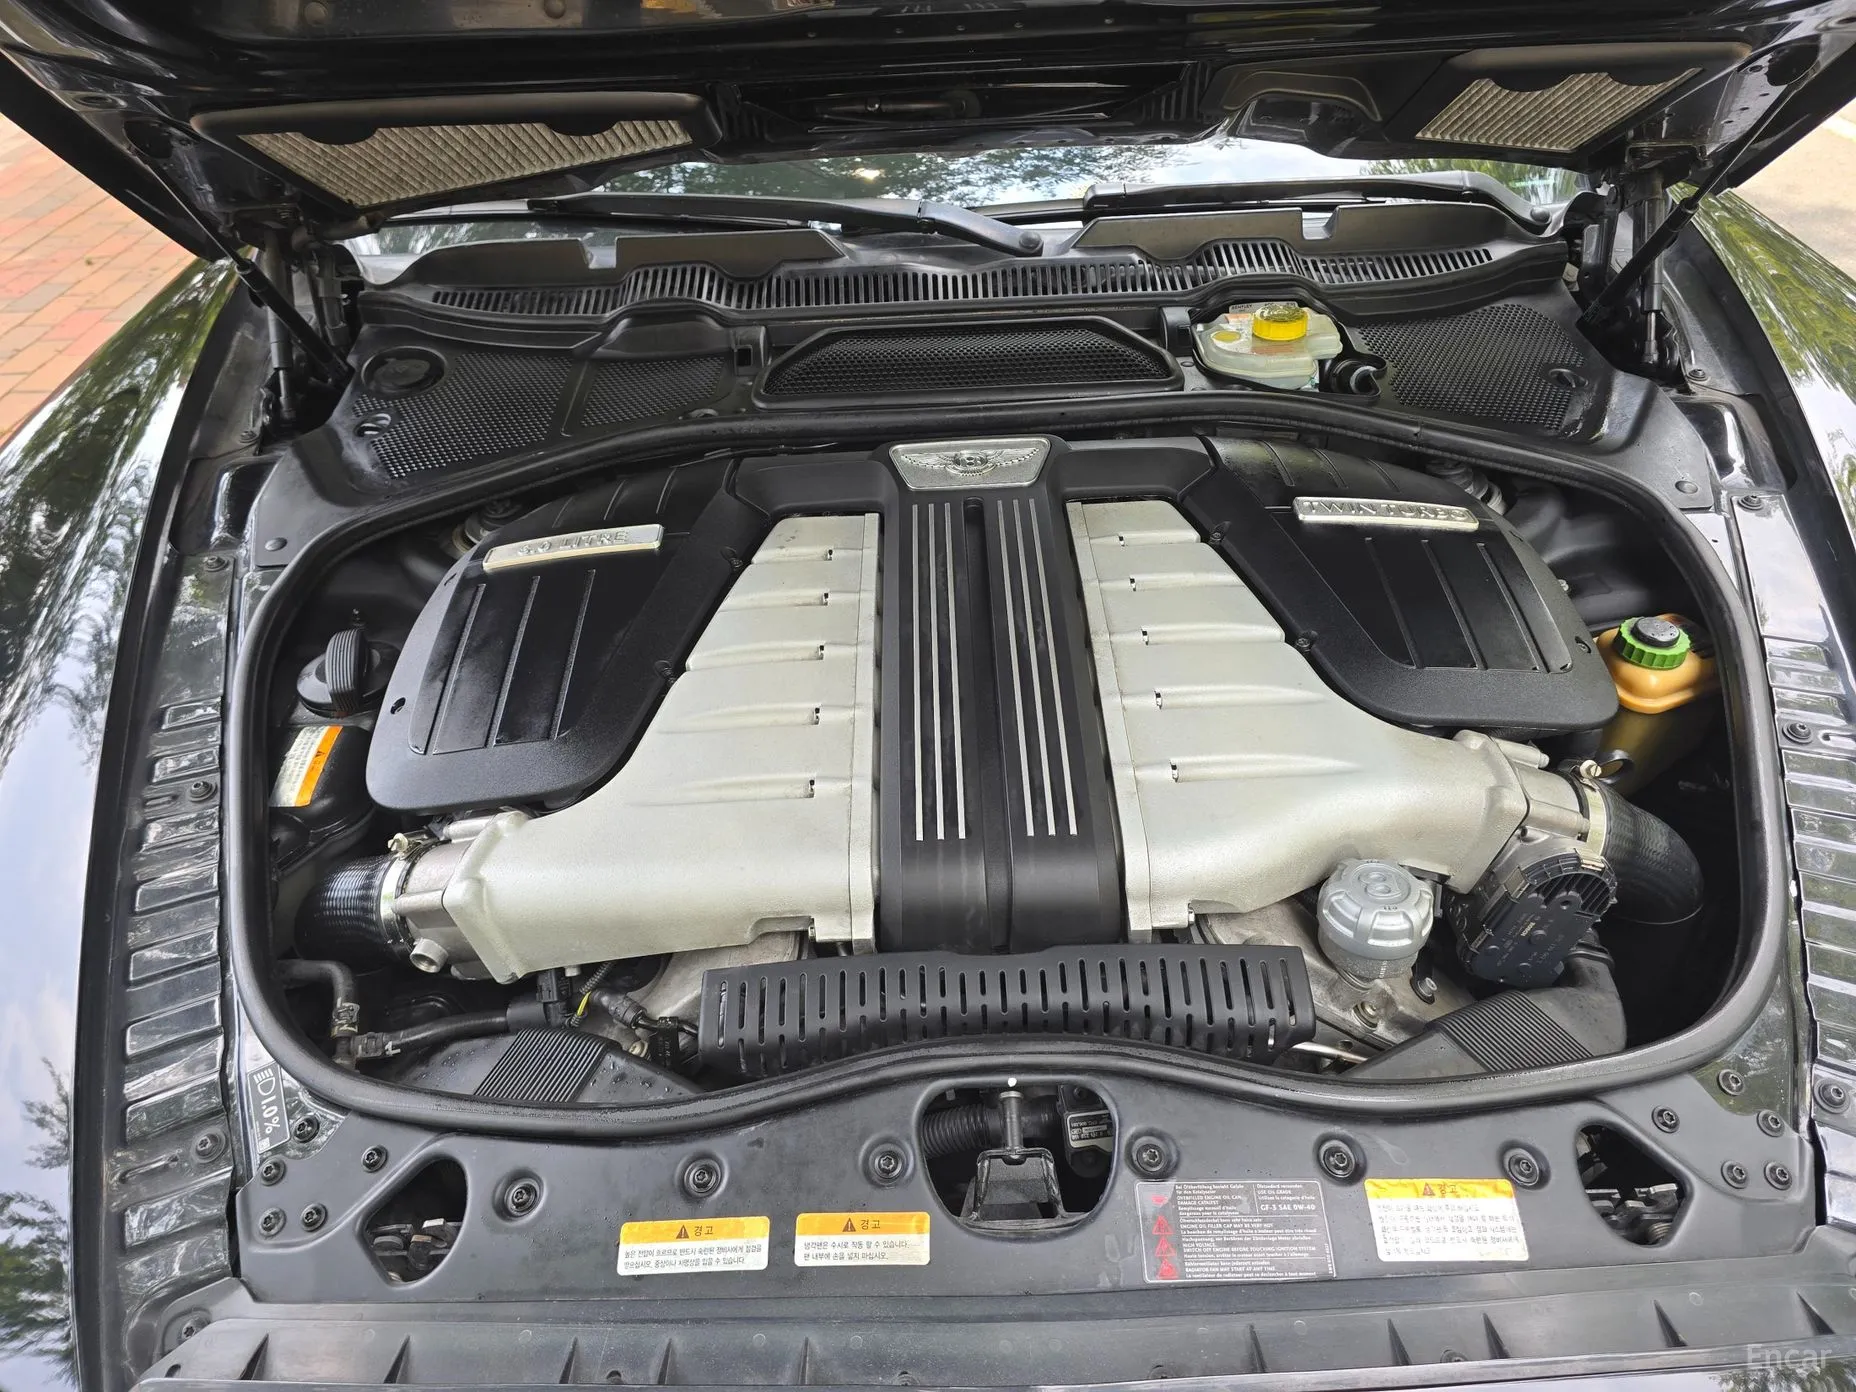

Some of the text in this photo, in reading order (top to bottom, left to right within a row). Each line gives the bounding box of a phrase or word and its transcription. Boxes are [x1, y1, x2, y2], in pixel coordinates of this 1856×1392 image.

[1302, 501, 1469, 520] TWIN TURBO
[559, 530, 629, 550] LITRE
[261, 1095, 281, 1134] 1.0%
[831, 1241, 849, 1249] 수시로
[851, 1240, 864, 1249] 작동
[874, 1240, 880, 1248] 수
